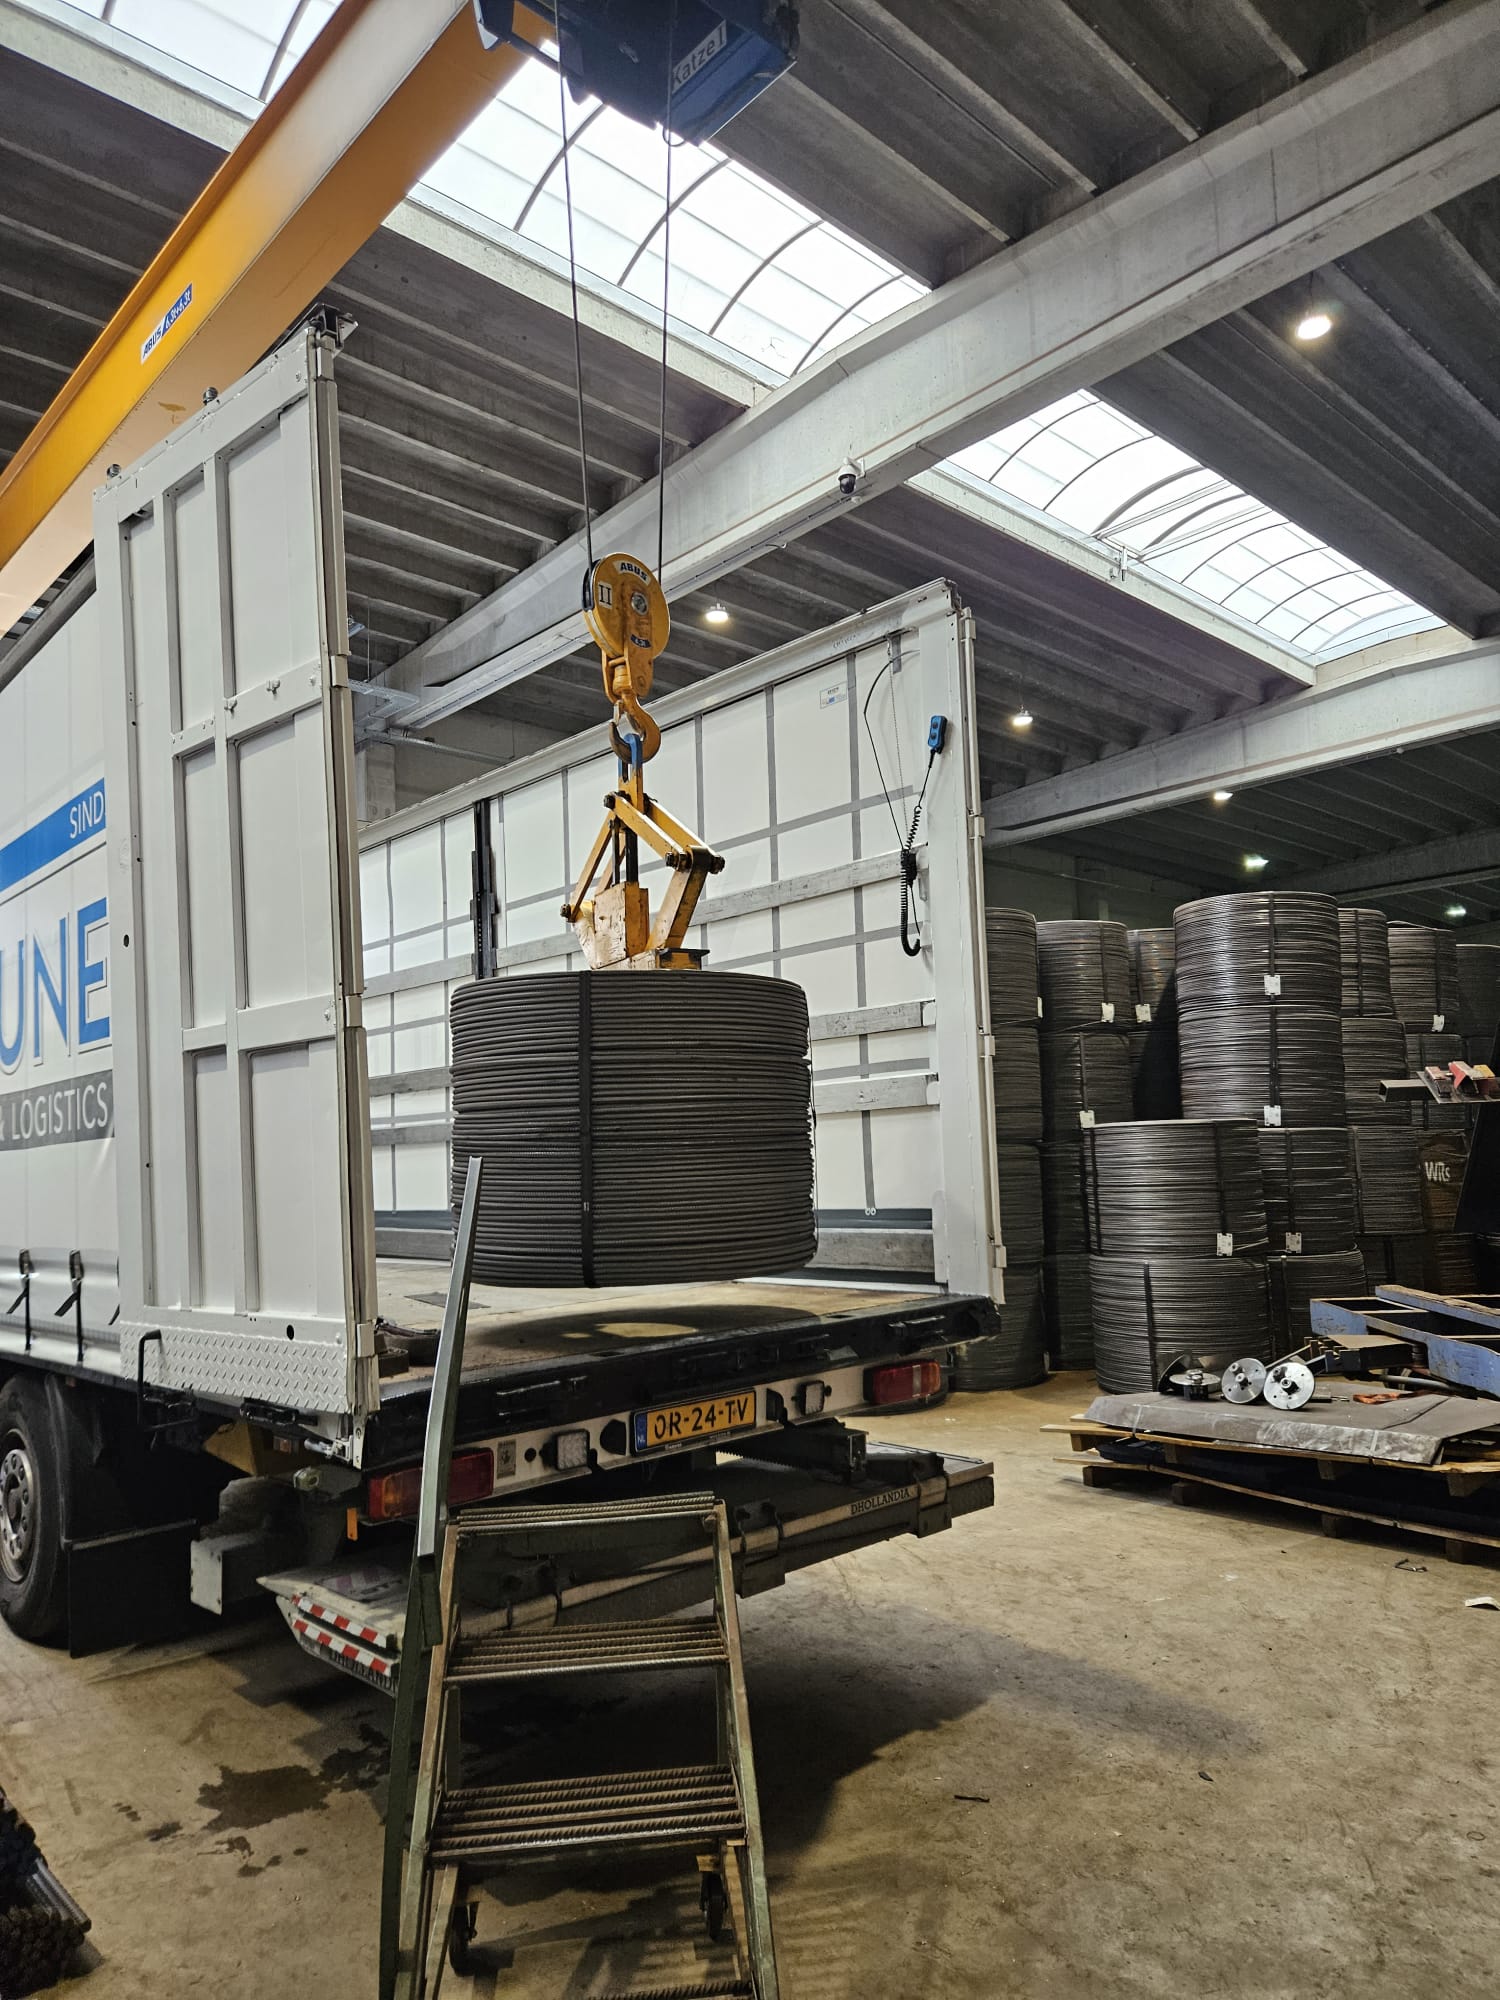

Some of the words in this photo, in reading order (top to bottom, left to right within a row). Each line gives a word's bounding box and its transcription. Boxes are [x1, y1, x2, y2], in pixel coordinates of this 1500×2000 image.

[671, 39, 715, 92] Katze
[143, 326, 161, 359] ABUS
[620, 562, 648, 580] ABUS
[70, 791, 104, 839] SIND
[0, 897, 111, 1070] UNE
[12, 1082, 108, 1140] LOGISTICS
[637, 1433, 646, 1443] NL
[654, 1397, 749, 1440] OR-24-TV
[850, 1488, 911, 1515] DHOLLANDIA
